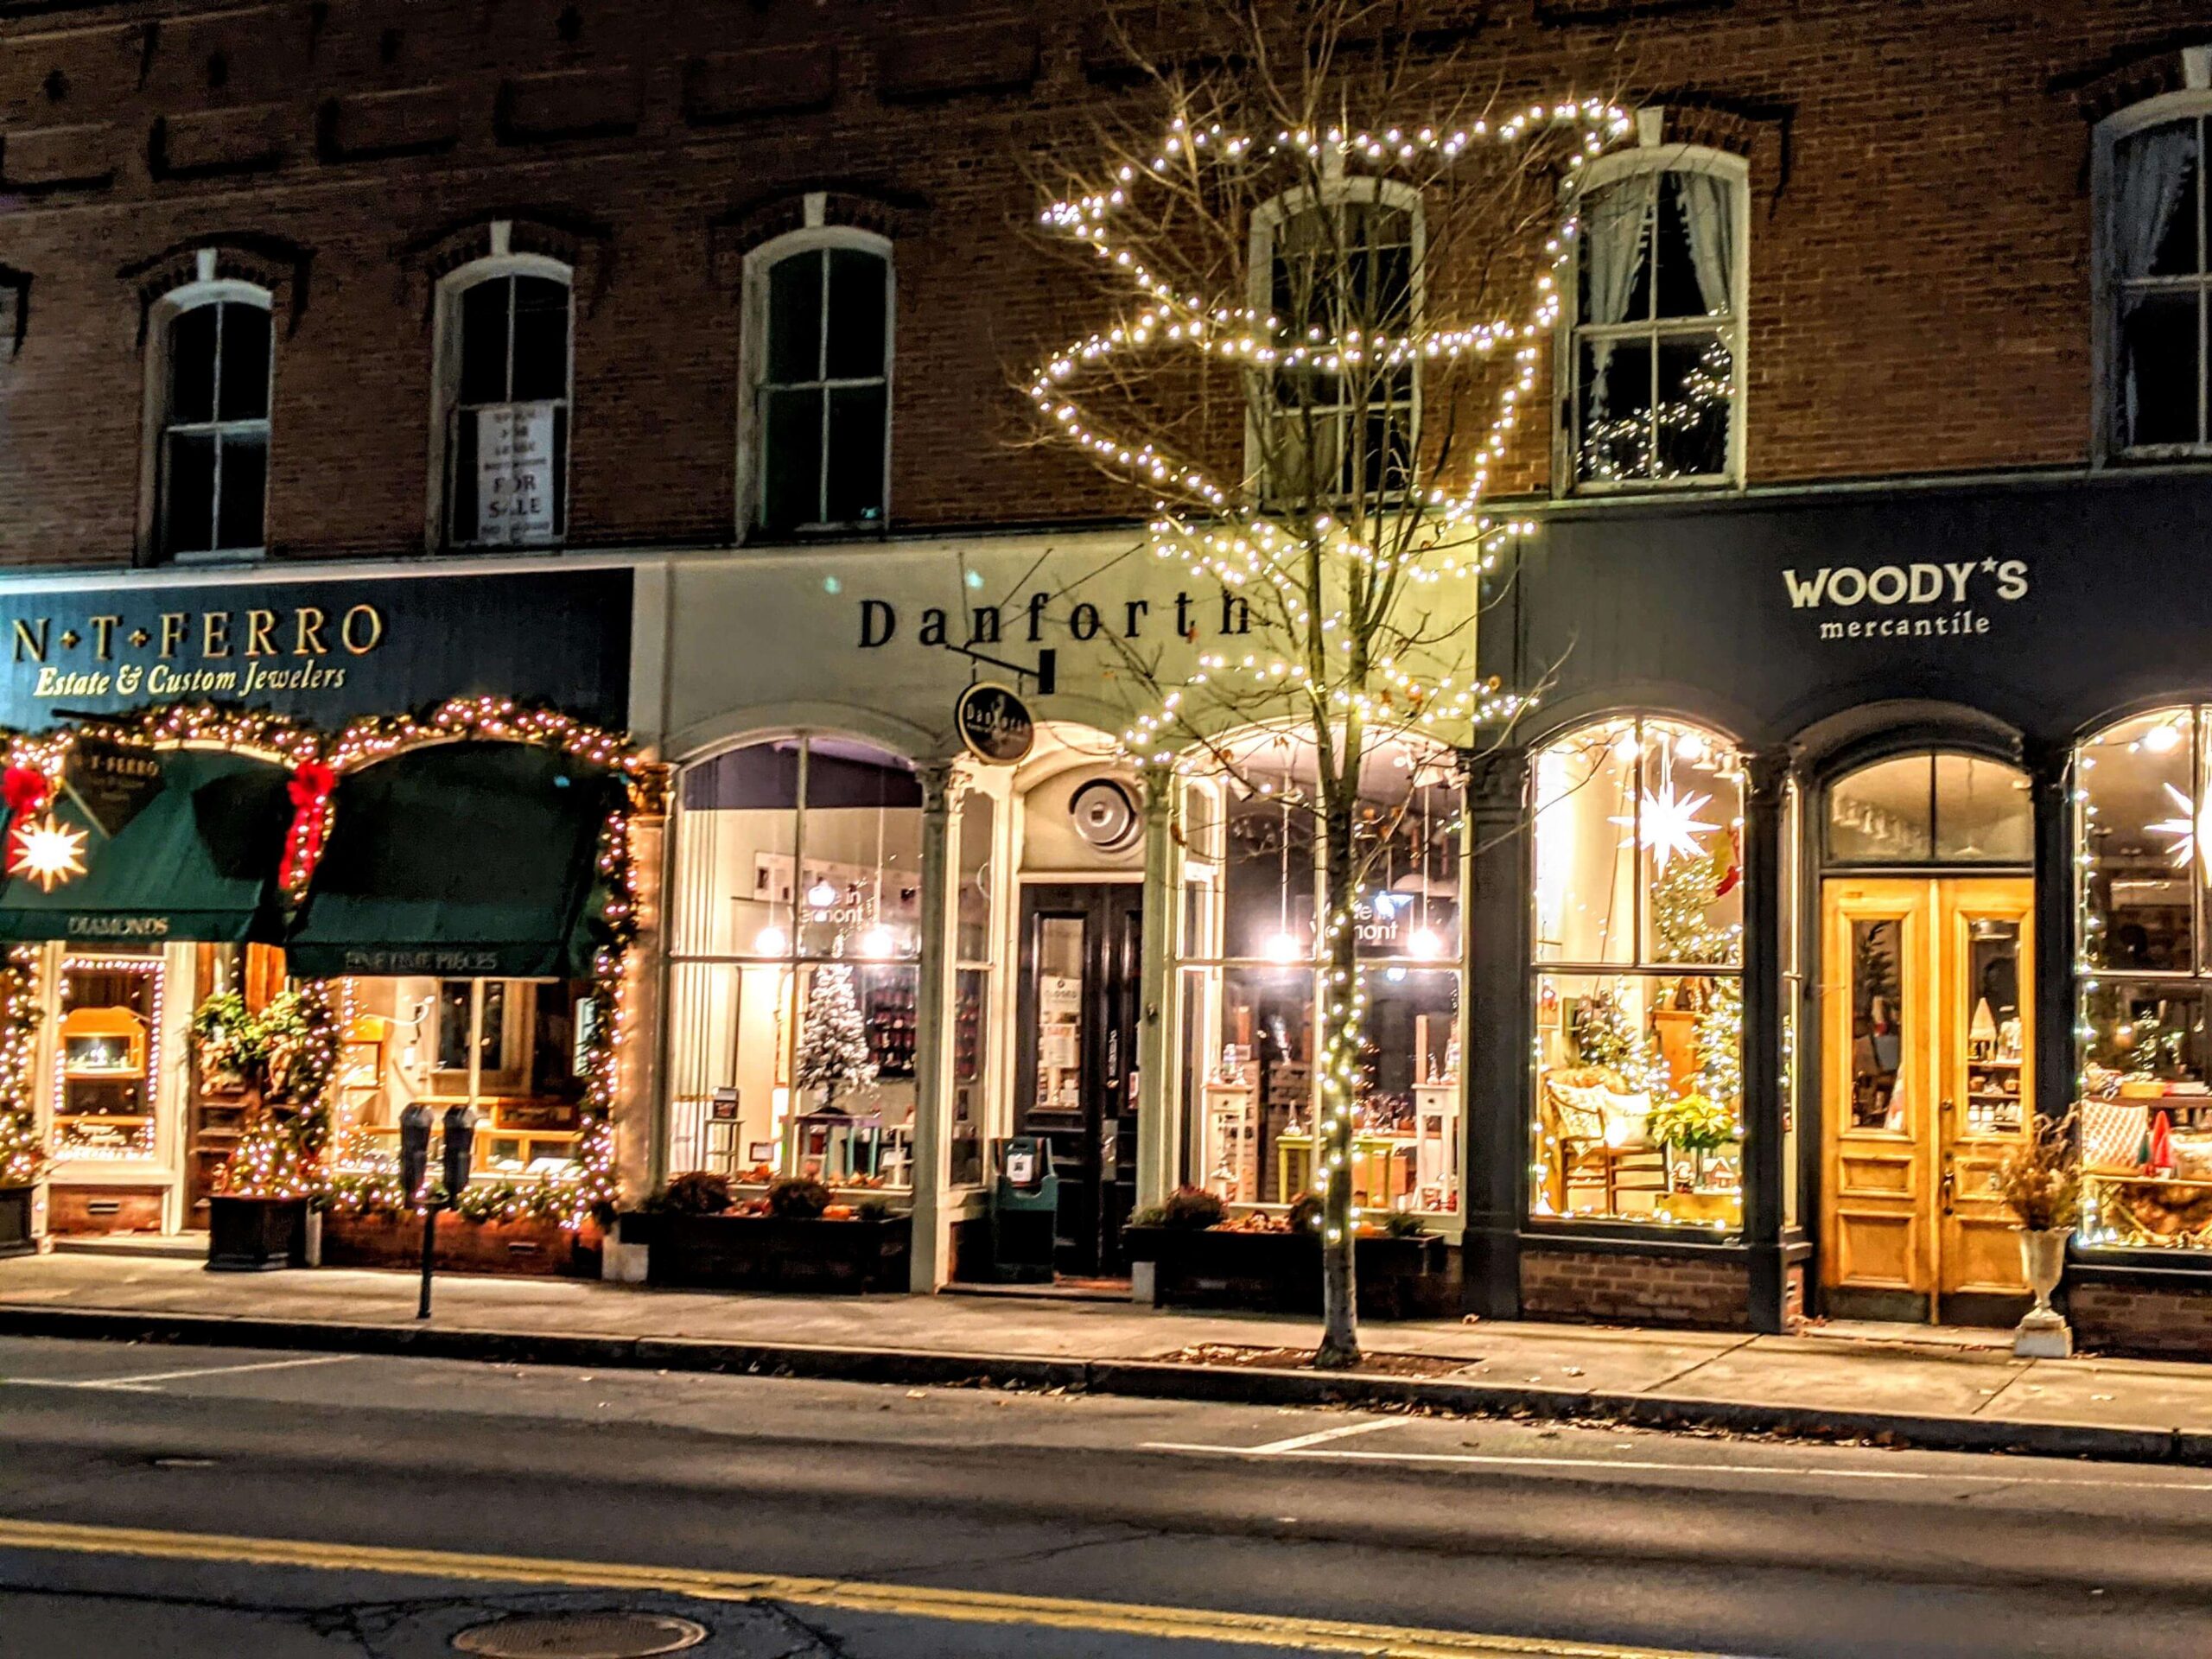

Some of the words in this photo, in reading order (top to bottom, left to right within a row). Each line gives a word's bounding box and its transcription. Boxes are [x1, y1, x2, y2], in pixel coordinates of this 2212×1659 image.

[858, 588, 1251, 647] Danforth
[1820, 610, 1991, 639] mercantile
[33, 666, 111, 696] Estate
[116, 664, 143, 695] &
[148, 664, 238, 696] Custom
[238, 658, 346, 697] Jewelers
[68, 916, 169, 935] DIAMONDS
[1309, 920, 1399, 940] Vemont
